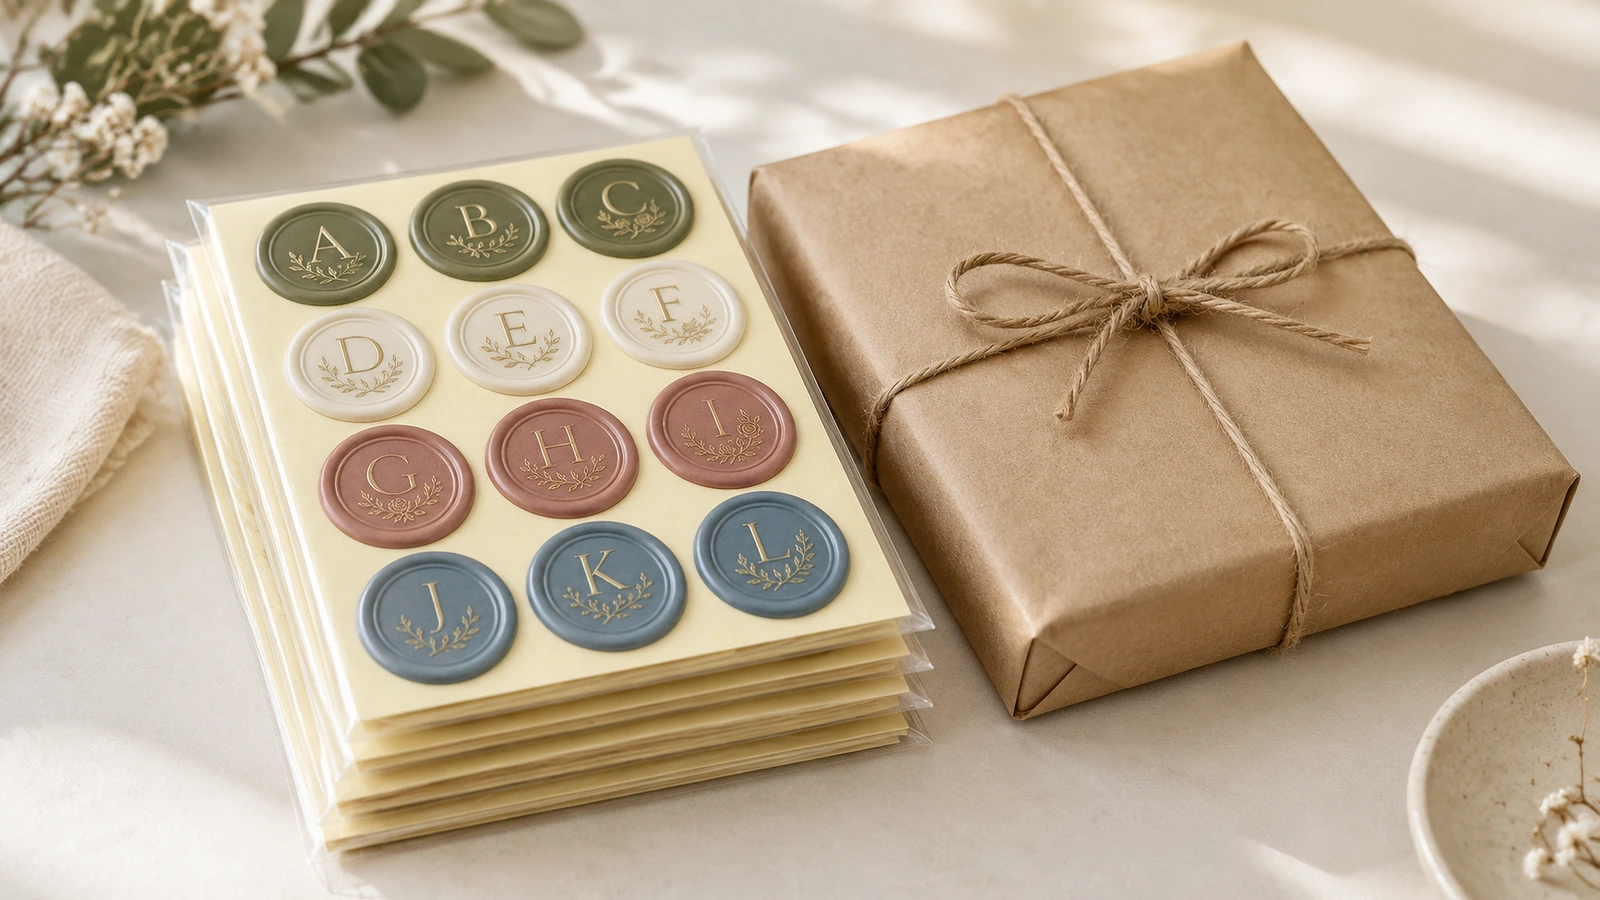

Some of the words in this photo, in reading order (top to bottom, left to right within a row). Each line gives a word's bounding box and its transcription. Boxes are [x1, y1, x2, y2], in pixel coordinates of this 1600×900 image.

[601, 180, 648, 216] C
[455, 203, 498, 240] B
[310, 225, 353, 263] A
[649, 284, 680, 323] F
[495, 309, 537, 348] E
[336, 335, 385, 375] D
[701, 398, 731, 438] I
[530, 424, 588, 470] H
[366, 453, 419, 496] G
[742, 520, 791, 563] L
[573, 548, 631, 597] K
[421, 580, 445, 634] J
